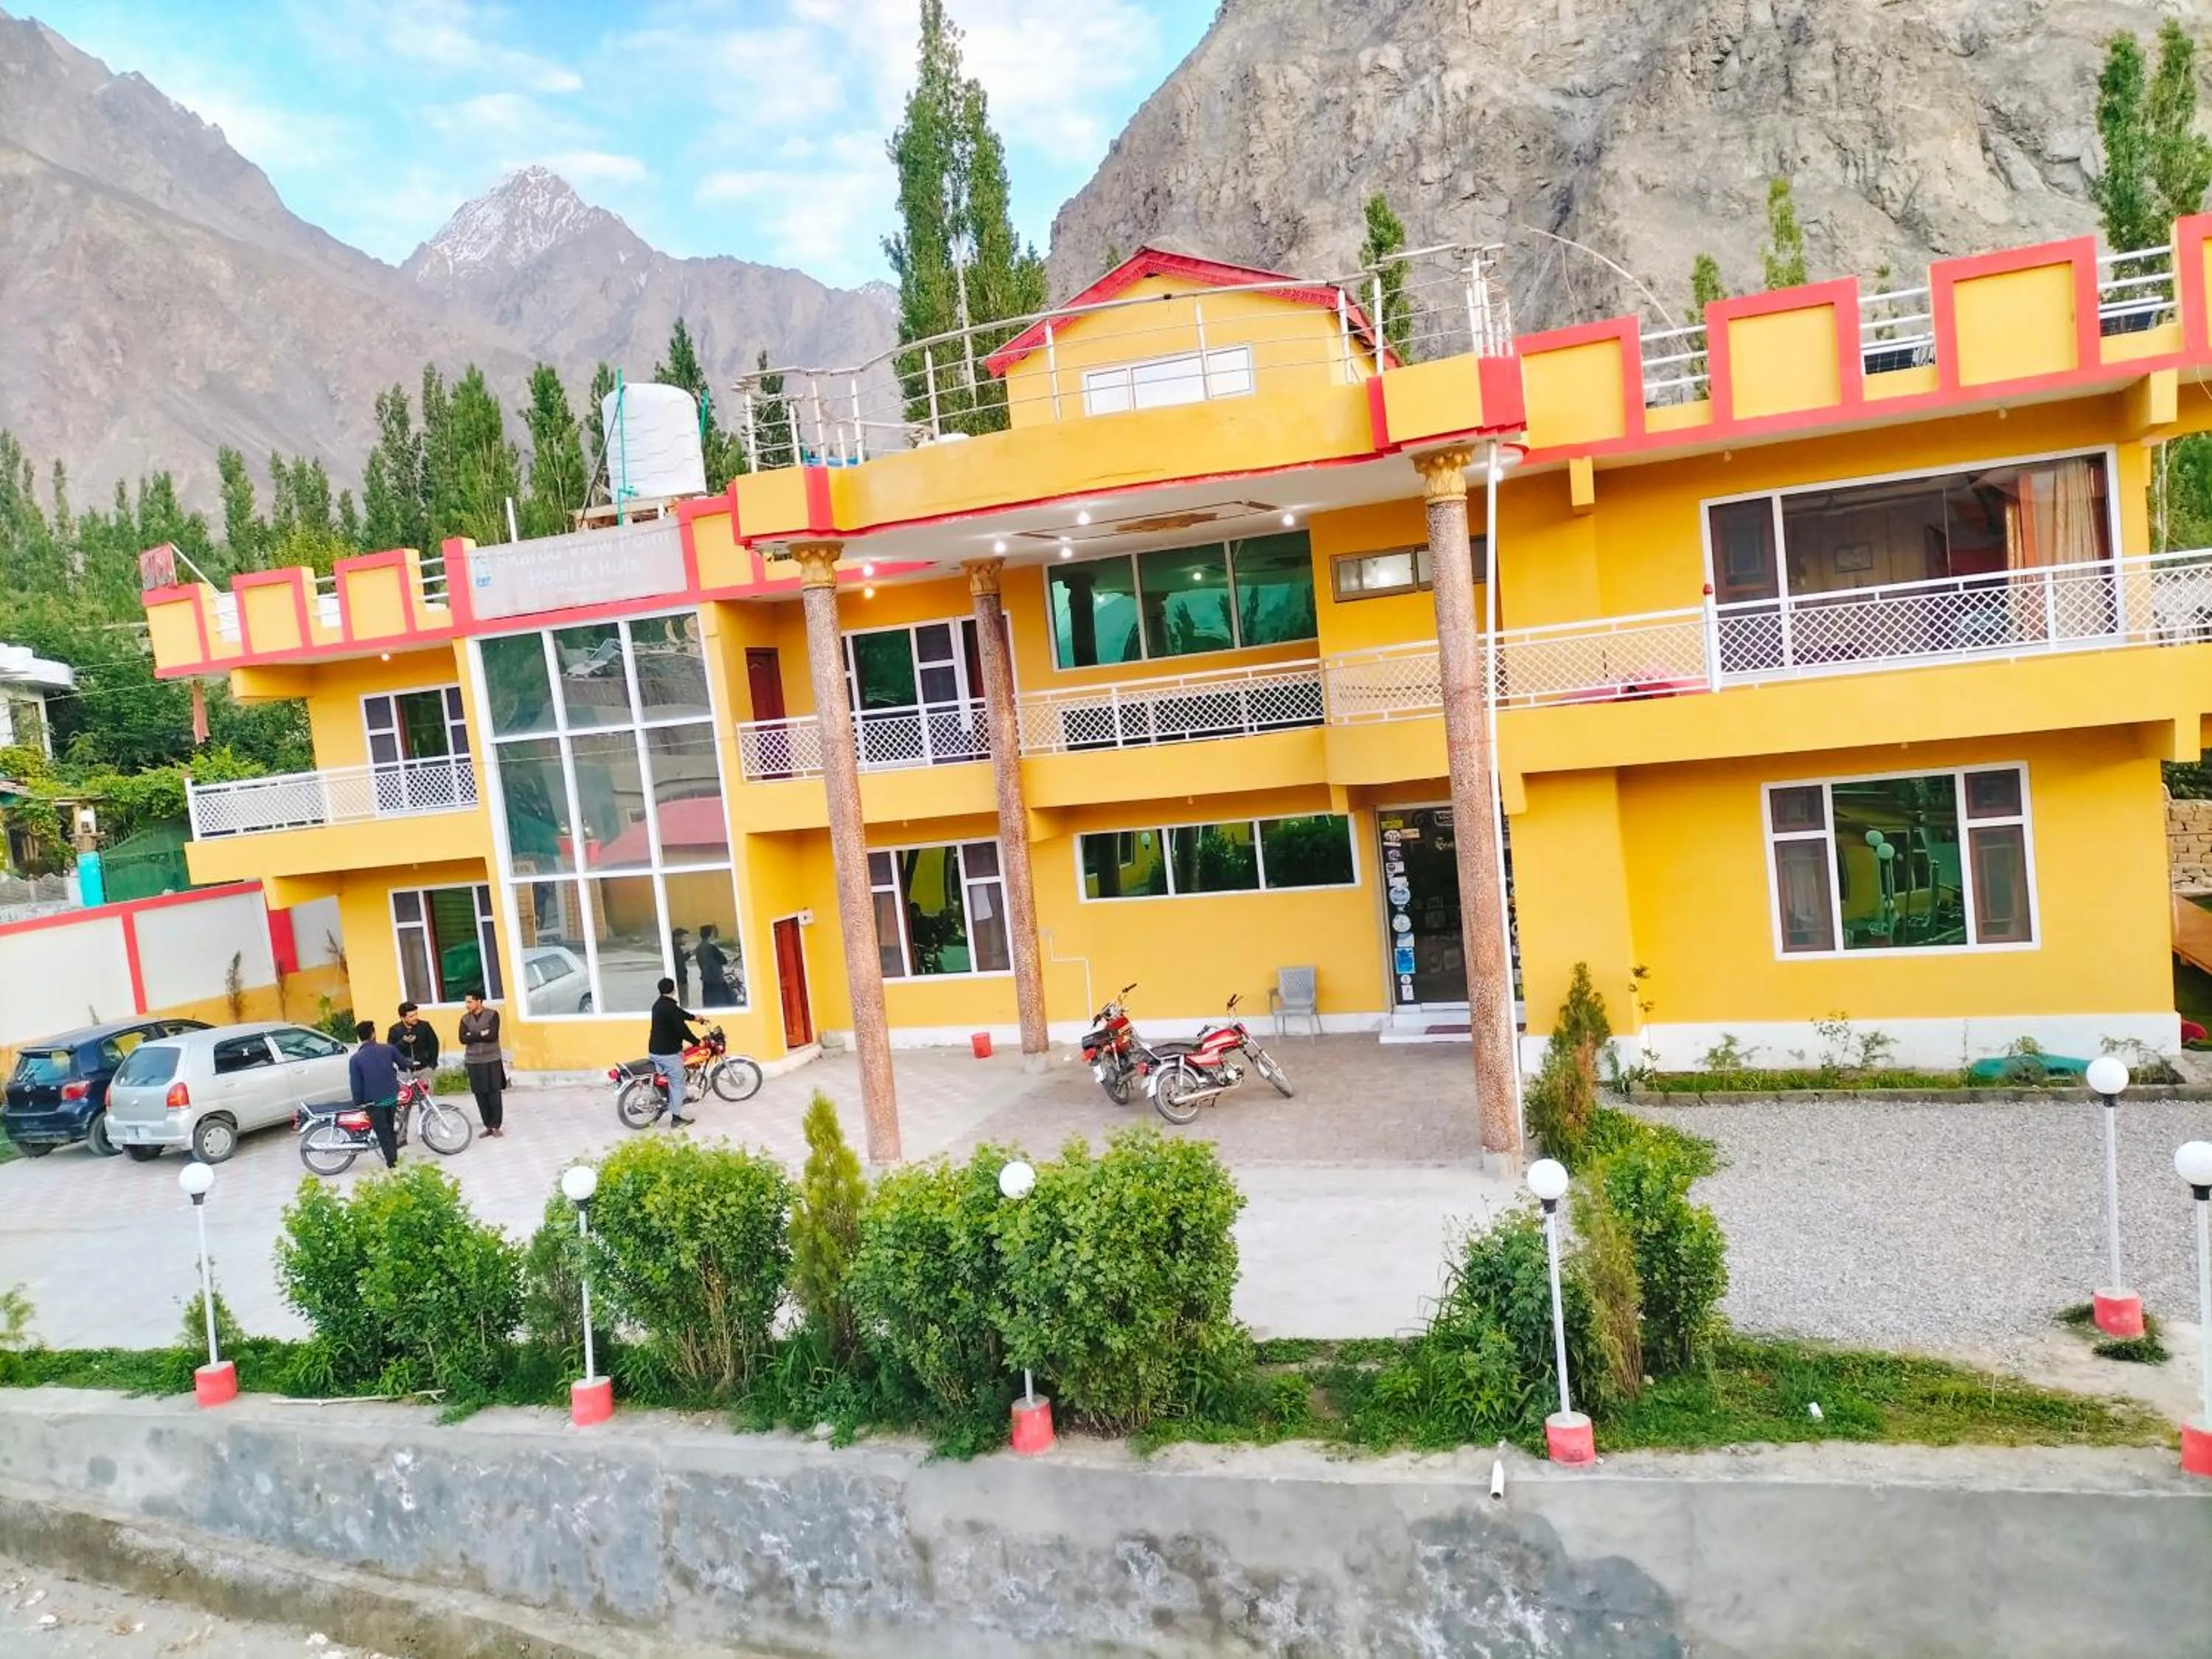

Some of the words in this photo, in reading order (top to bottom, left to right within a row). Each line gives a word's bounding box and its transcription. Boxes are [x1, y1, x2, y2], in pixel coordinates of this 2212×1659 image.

[528, 563, 576, 587] Hotel
[580, 565, 593, 580] &
[598, 559, 641, 579] Huts
